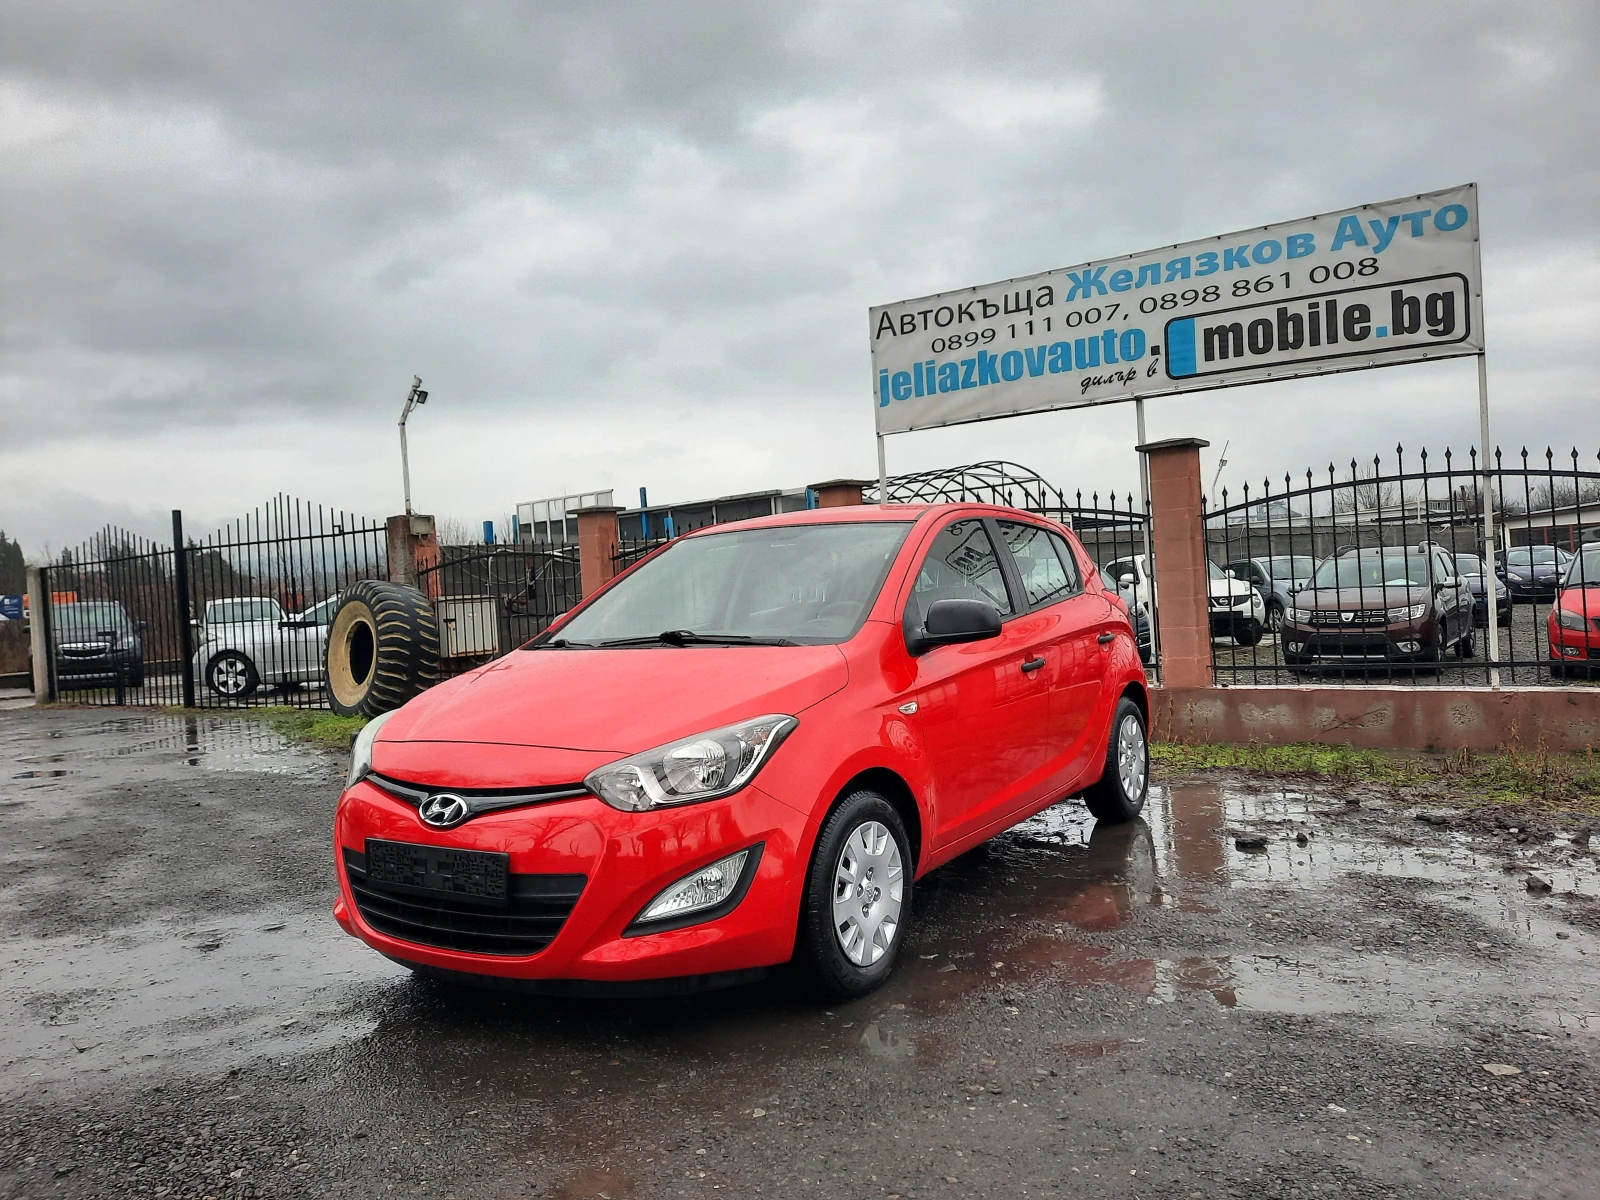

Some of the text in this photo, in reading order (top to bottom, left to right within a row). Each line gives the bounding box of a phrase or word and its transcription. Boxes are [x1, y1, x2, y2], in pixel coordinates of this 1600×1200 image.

[876, 203, 1469, 340] Автокъща Желязков Ауто
[931, 257, 1380, 353] 0899 111 007, 0898 861 008
[1203, 288, 1456, 362] mobile.bg
[1080, 357, 1159, 395] дилър в
